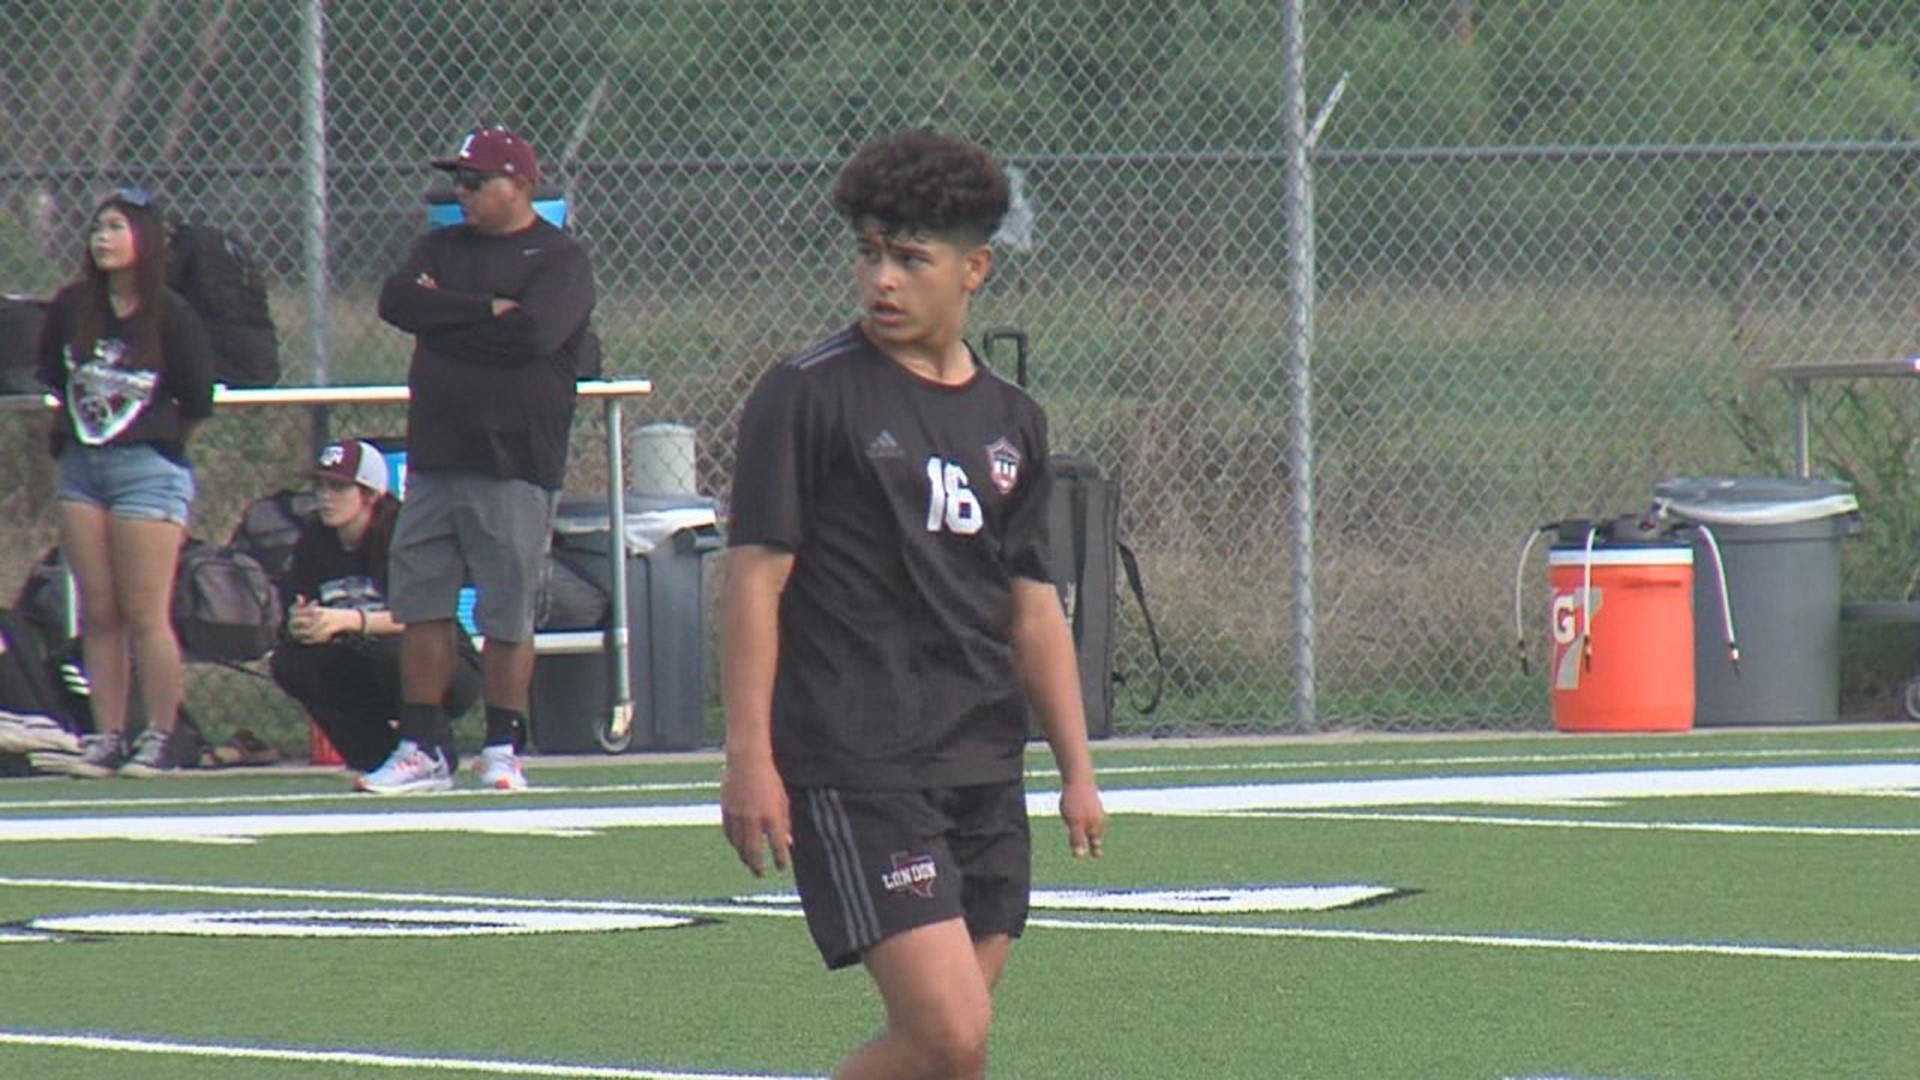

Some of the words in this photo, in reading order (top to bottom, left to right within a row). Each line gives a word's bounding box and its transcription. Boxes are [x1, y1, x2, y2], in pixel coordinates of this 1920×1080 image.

[926, 456, 983, 534] 16
[1553, 595, 1576, 643] G
[881, 861, 937, 890] LONDON
